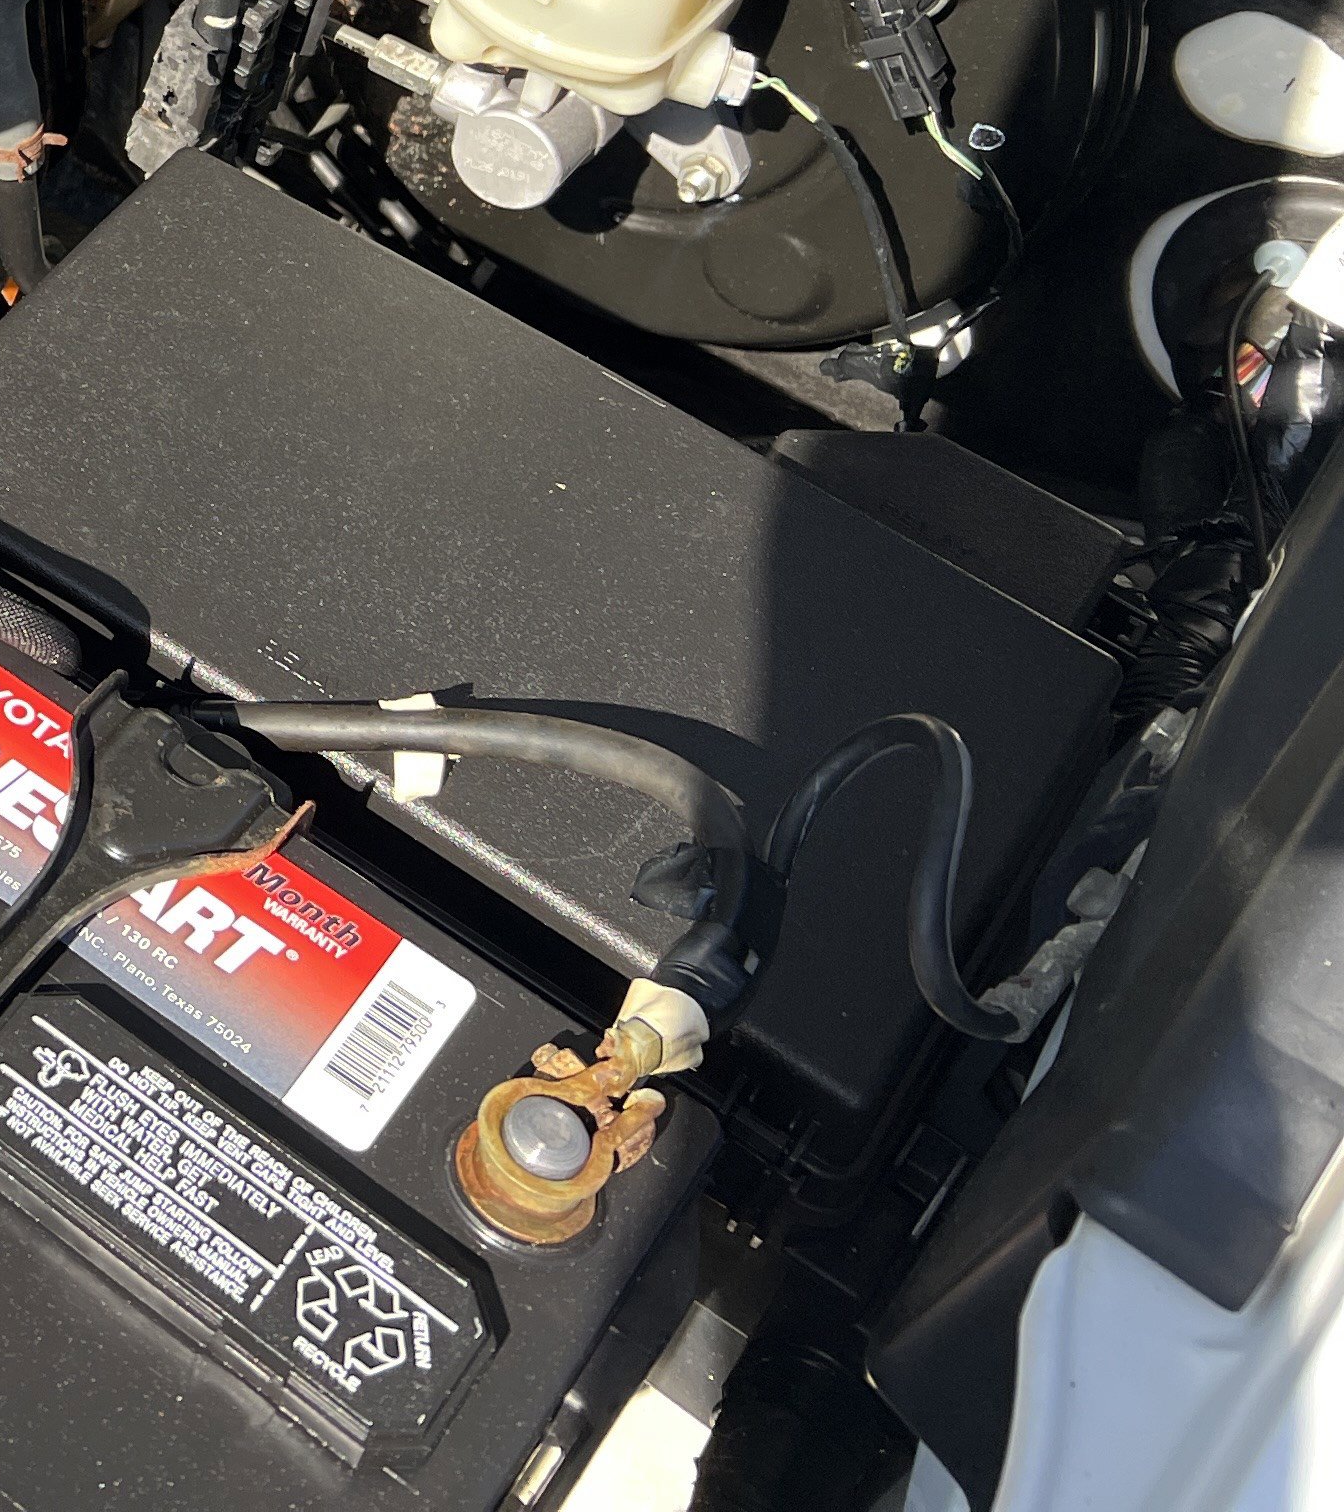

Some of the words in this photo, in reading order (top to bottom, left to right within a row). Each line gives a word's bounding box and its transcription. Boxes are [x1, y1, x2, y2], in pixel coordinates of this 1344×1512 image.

[121, 924, 151, 951] 130
[152, 946, 179, 970] RC
[243, 861, 362, 949] Month
[262, 896, 348, 959] WARRANTY
[113, 951, 158, 992] Plano,
[161, 986, 203, 1020] Texas
[206, 1015, 252, 1054] 75024
[372, 1054, 407, 1094] 21112
[400, 1018, 434, 1055] 79500
[5, 1097, 87, 1162] INSTRUCTIONS
[84, 1157, 101, 1175] IN
[99, 1167, 150, 1210] VEHICLE
[6, 1115, 35, 1140] NOT
[31, 1135, 94, 1186] AVAILABLE
[90, 1179, 124, 1210] SEEK
[121, 1203, 173, 1247] SERVICE
[69, 1098, 134, 1154] MEDICAL
[134, 1146, 177, 1182] HELP
[175, 1176, 220, 1213] FAST
[80, 1085, 121, 1121] WITH
[176, 1157, 213, 1188] GET
[89, 1073, 141, 1115] FLUSH
[138, 1109, 180, 1146] EYES
[179, 1140, 282, 1219] IMMEDIATELY
[108, 1056, 131, 1076] DO
[128, 1072, 160, 1096] NOT
[157, 1091, 180, 1116] TIP.
[183, 1112, 218, 1139] KEEP
[216, 1138, 253, 1166] VENT
[250, 1161, 287, 1192] CAPS
[287, 1186, 327, 1221] TIGHT
[325, 1217, 356, 1243] AND
[140, 1065, 175, 1092] KEEP
[174, 1090, 204, 1115] OUT
[202, 1110, 224, 1130] OF
[222, 1124, 251, 1149] THE
[248, 1144, 293, 1181] REACH
[292, 1176, 315, 1197] OF
[312, 1190, 378, 1244] CHILDREN
[63, 1123, 91, 1150] FOR
[89, 1144, 122, 1173] SAFE
[119, 1168, 154, 1196] JUMP
[151, 1191, 213, 1242] STARTING
[210, 1233, 263, 1279] FOLLOW
[305, 1245, 345, 1267] LEAD
[292, 1335, 362, 1393] RECYCLE
[412, 1310, 432, 1370] RETURN
